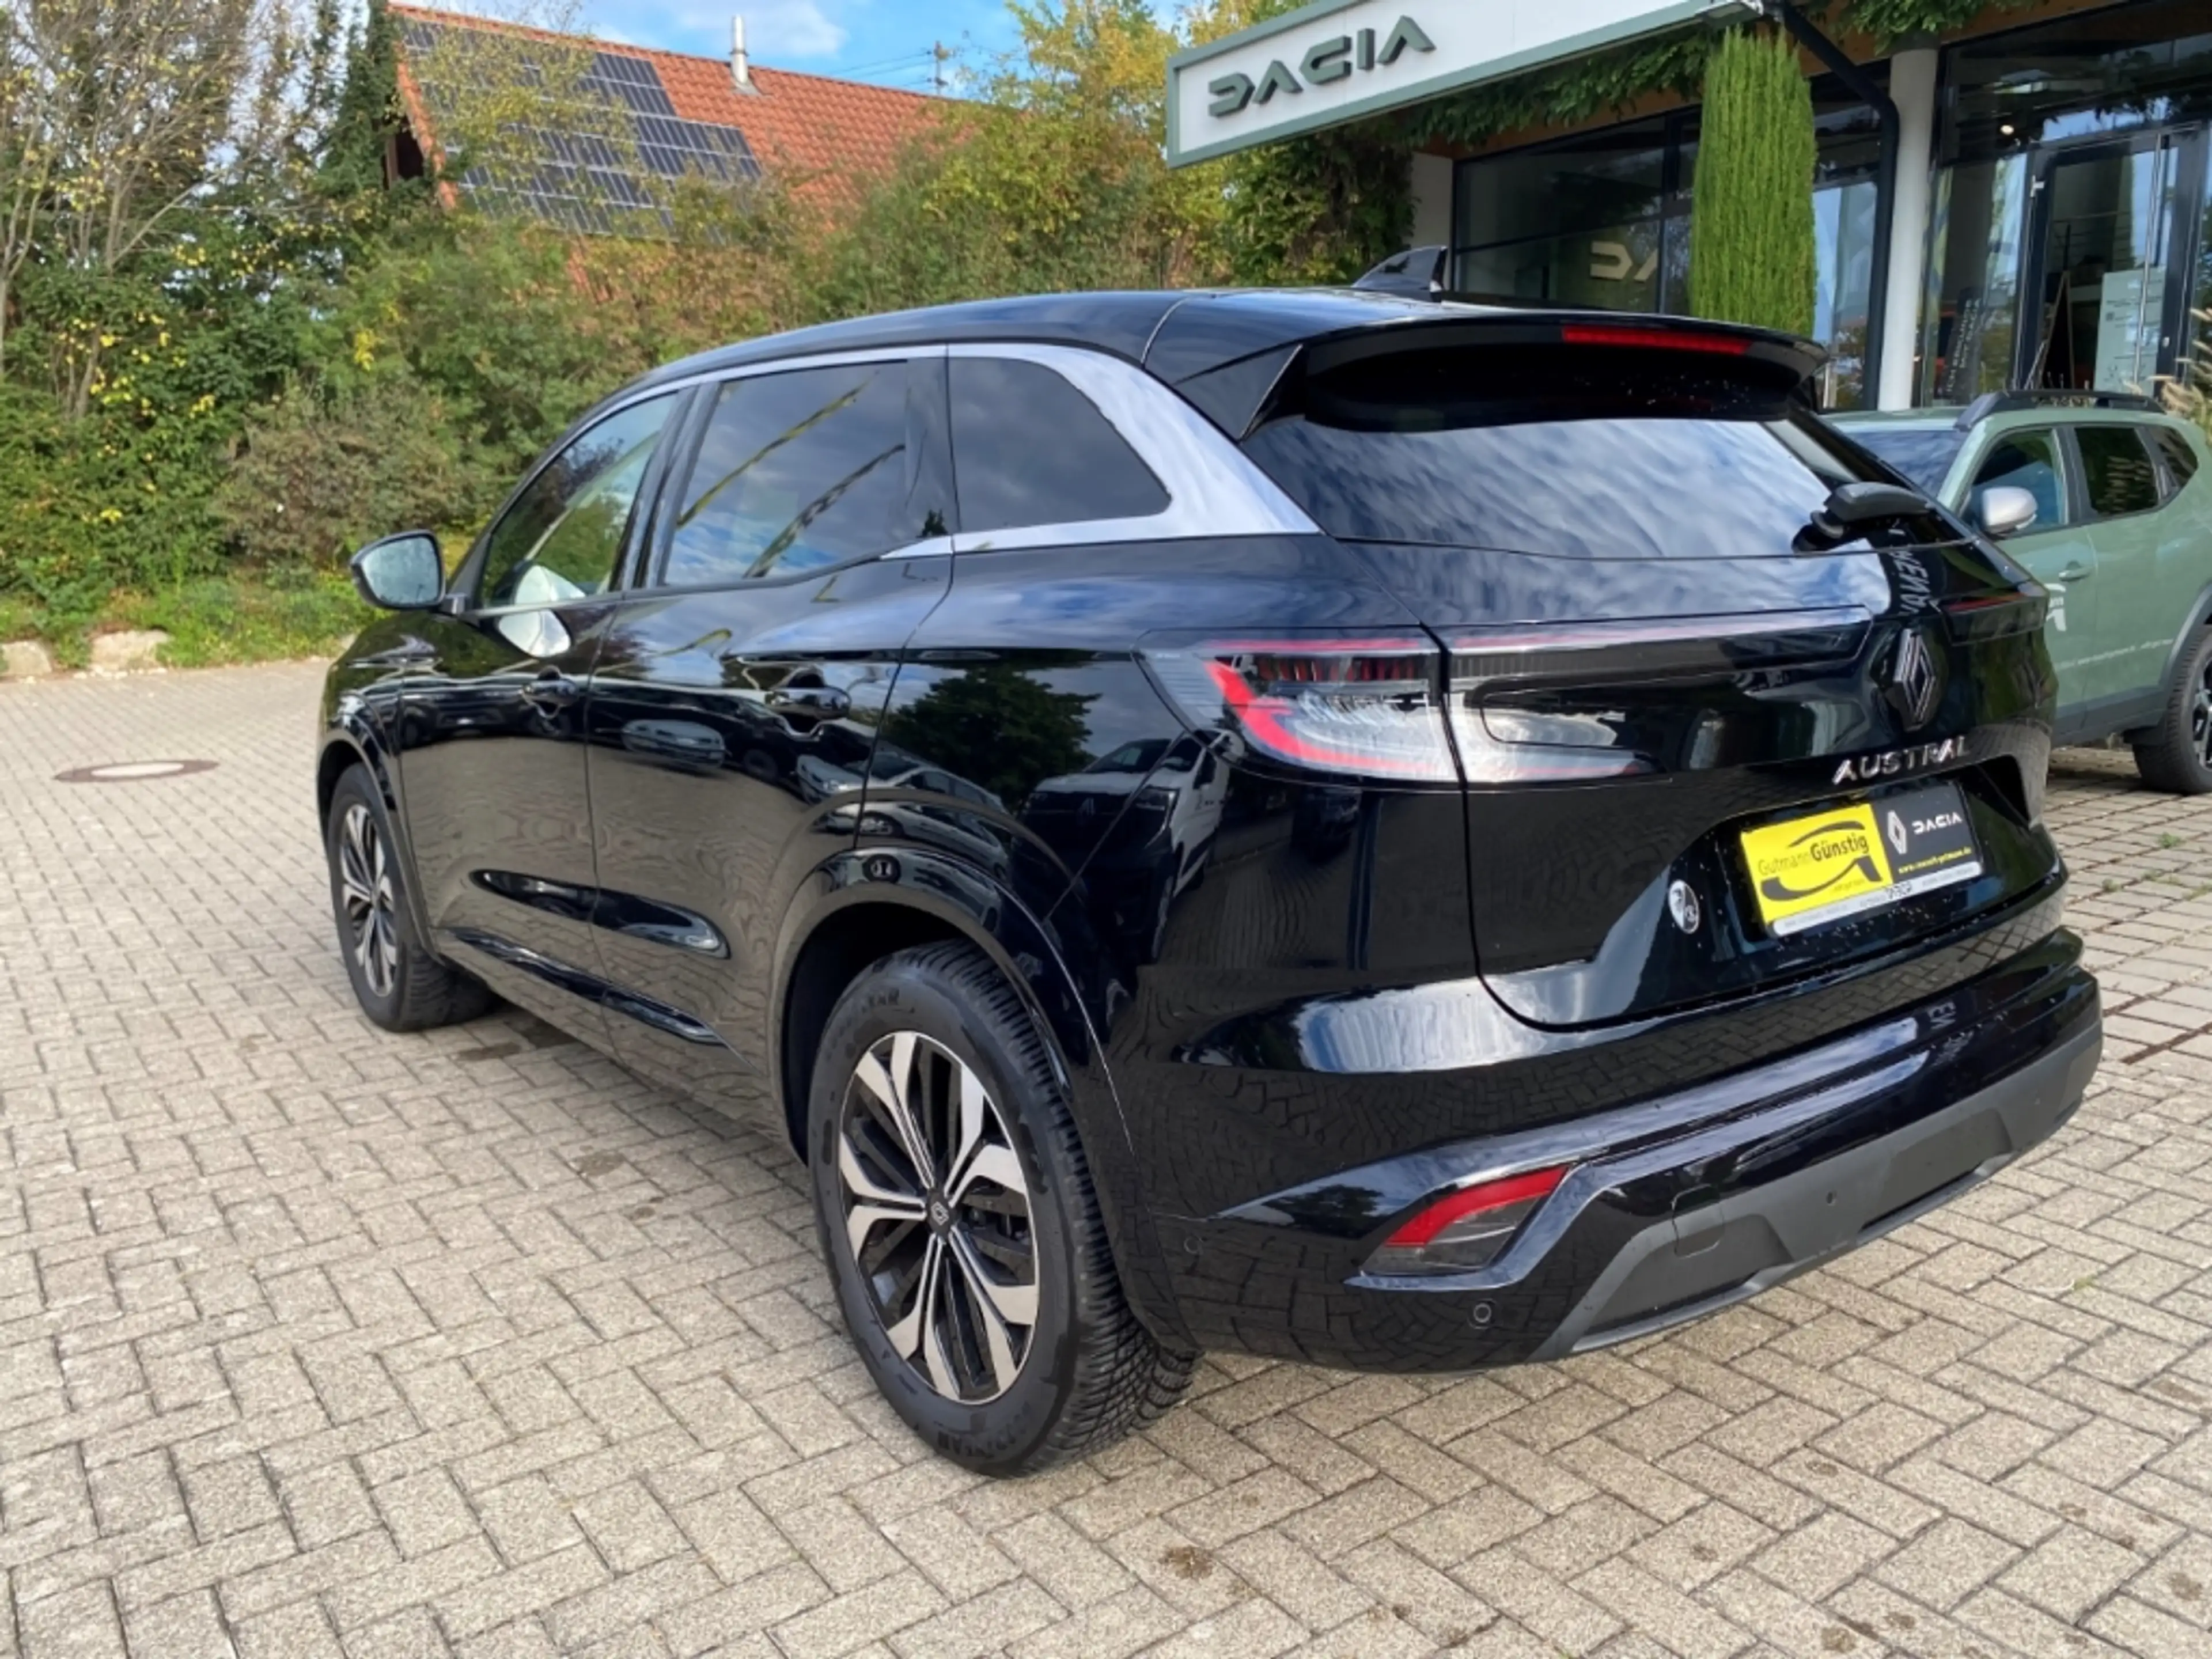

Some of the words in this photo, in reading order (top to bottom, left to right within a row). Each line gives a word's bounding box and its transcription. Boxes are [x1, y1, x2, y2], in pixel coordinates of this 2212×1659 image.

[1208, 15, 1437, 118] DACIA
[1831, 735, 1970, 786] AUSTRAL
[1911, 812, 1963, 835] DACIA
